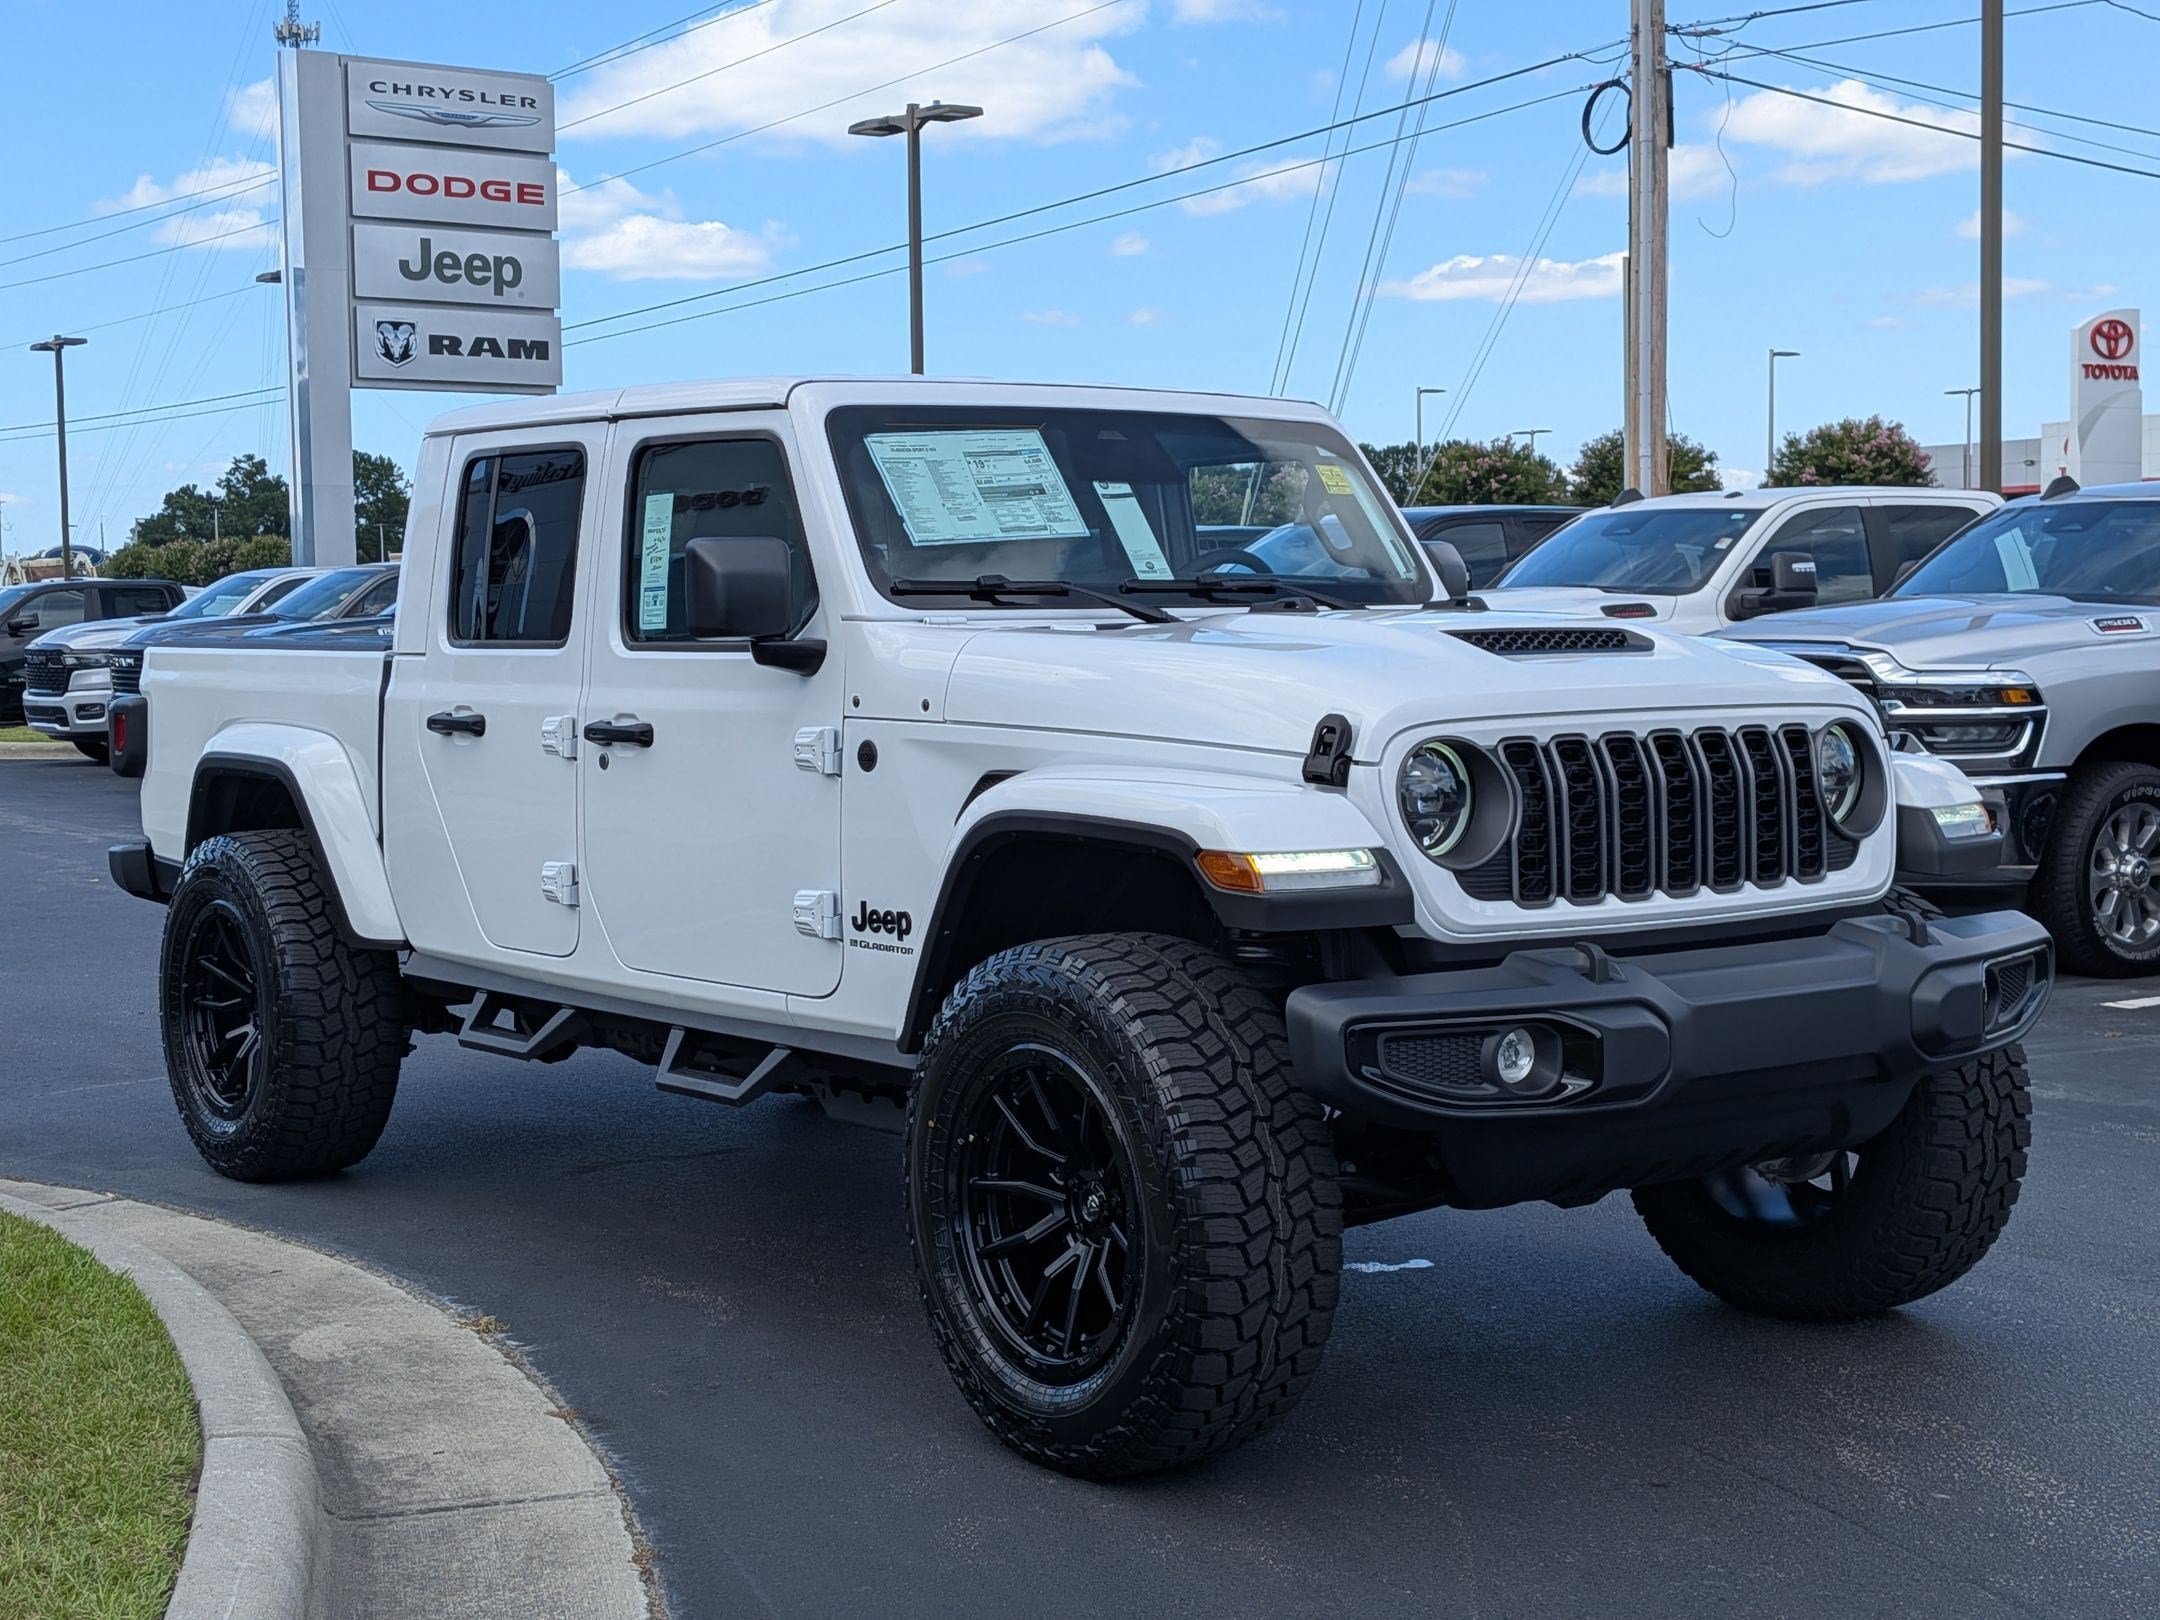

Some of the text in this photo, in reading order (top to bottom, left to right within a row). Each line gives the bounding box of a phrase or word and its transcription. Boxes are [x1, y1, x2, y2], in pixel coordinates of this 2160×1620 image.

[369, 81, 537, 109] CHRYSLER
[367, 170, 545, 206] DODGE
[399, 238, 523, 296] Jeep
[428, 334, 550, 361] RAM
[2082, 364, 2139, 380] TOYOTA
[851, 900, 912, 942] Jeep
[859, 940, 914, 955] GLADIATOR
